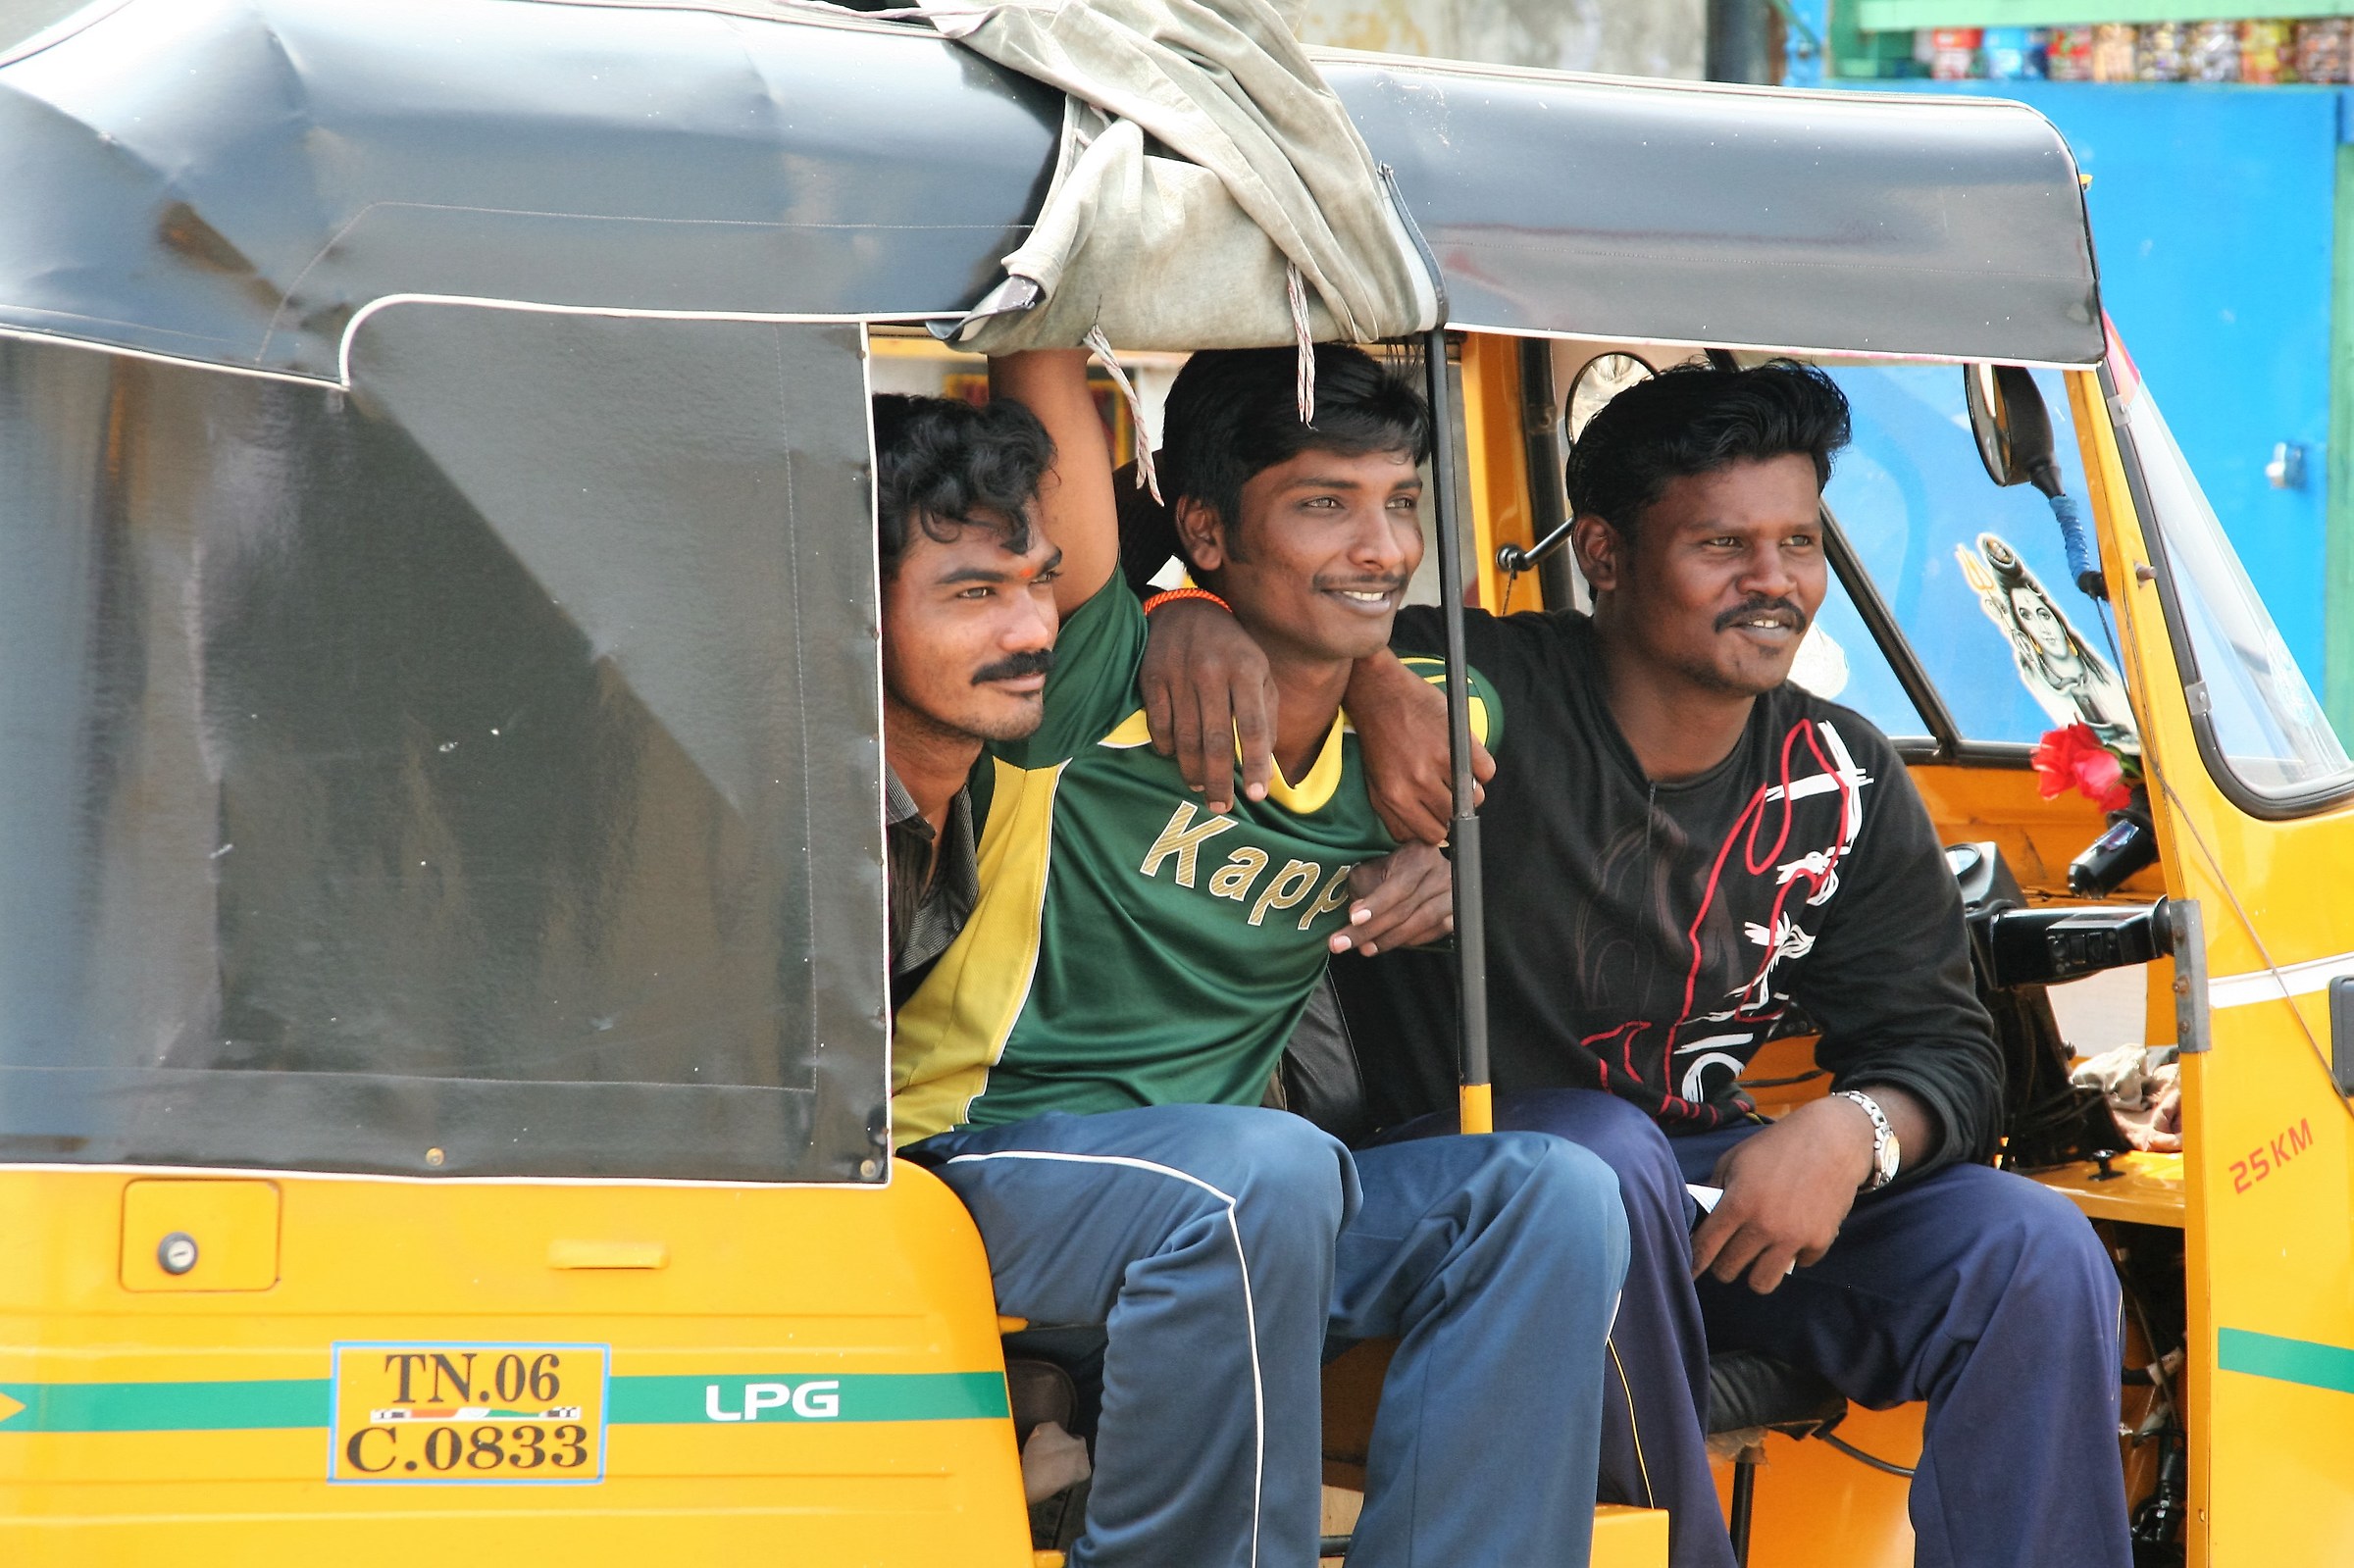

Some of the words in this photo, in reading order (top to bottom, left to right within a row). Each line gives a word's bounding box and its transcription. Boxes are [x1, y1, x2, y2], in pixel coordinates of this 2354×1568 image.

[384, 1352, 561, 1403] TN.06
[705, 1380, 840, 1421] LPG
[346, 1425, 588, 1472] C.0833
